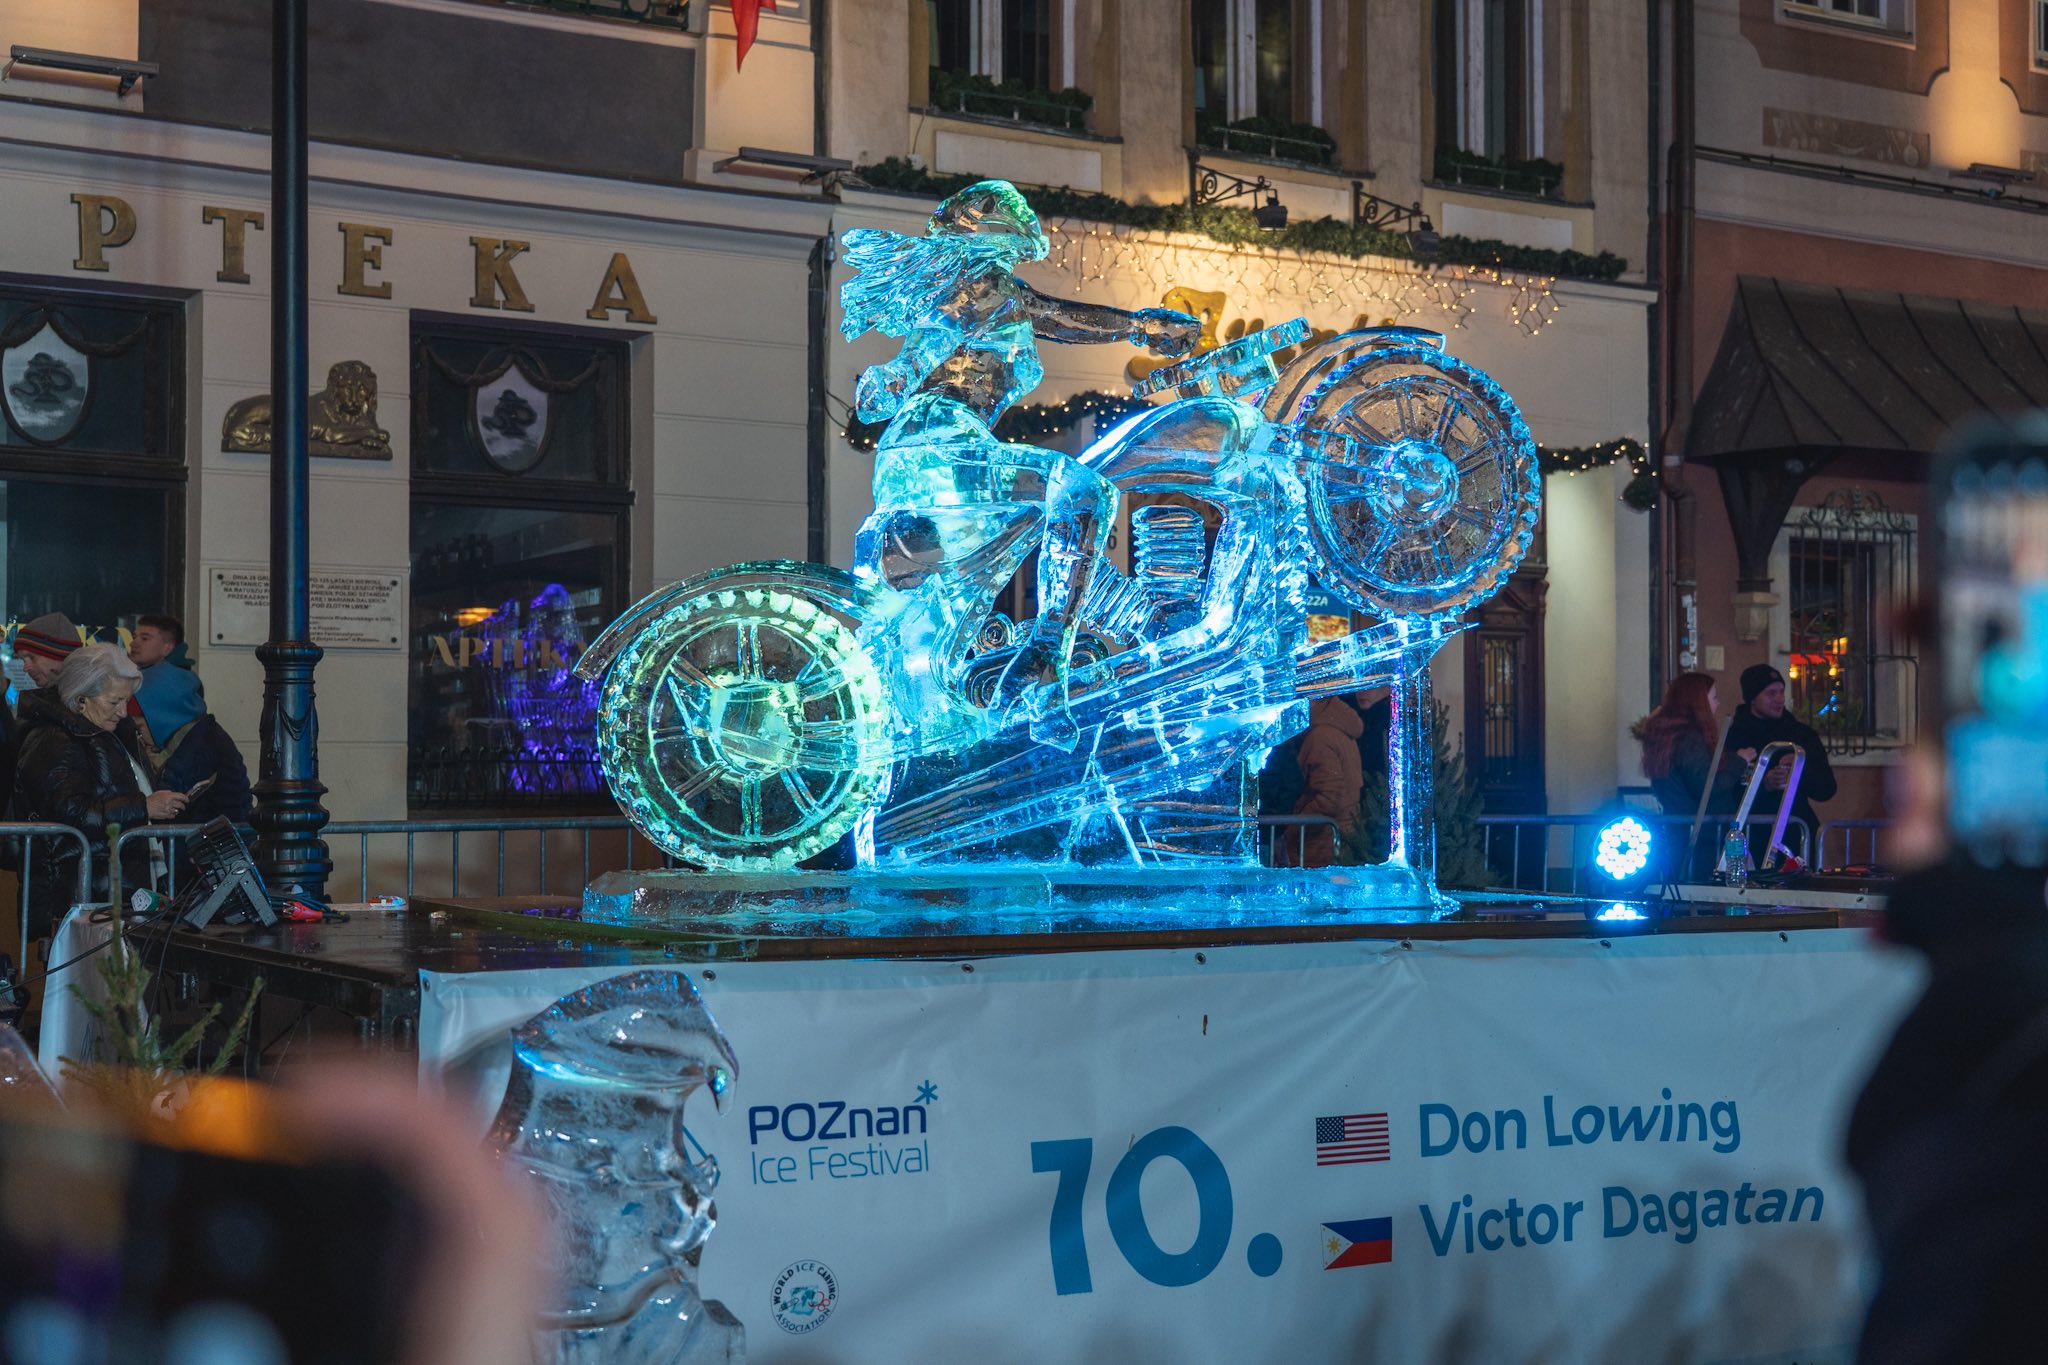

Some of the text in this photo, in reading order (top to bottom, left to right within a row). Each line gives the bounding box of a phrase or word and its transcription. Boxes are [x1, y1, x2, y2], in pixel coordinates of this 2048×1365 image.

[1419, 1087, 1741, 1158] Don Lowing
[750, 1139, 929, 1186] Ice Festival
[1419, 1182, 1825, 1257] Victor Dagatan
[773, 1262, 836, 1306] WORLD ICE CARVING
[775, 1308, 831, 1333] ASSOCIATION
